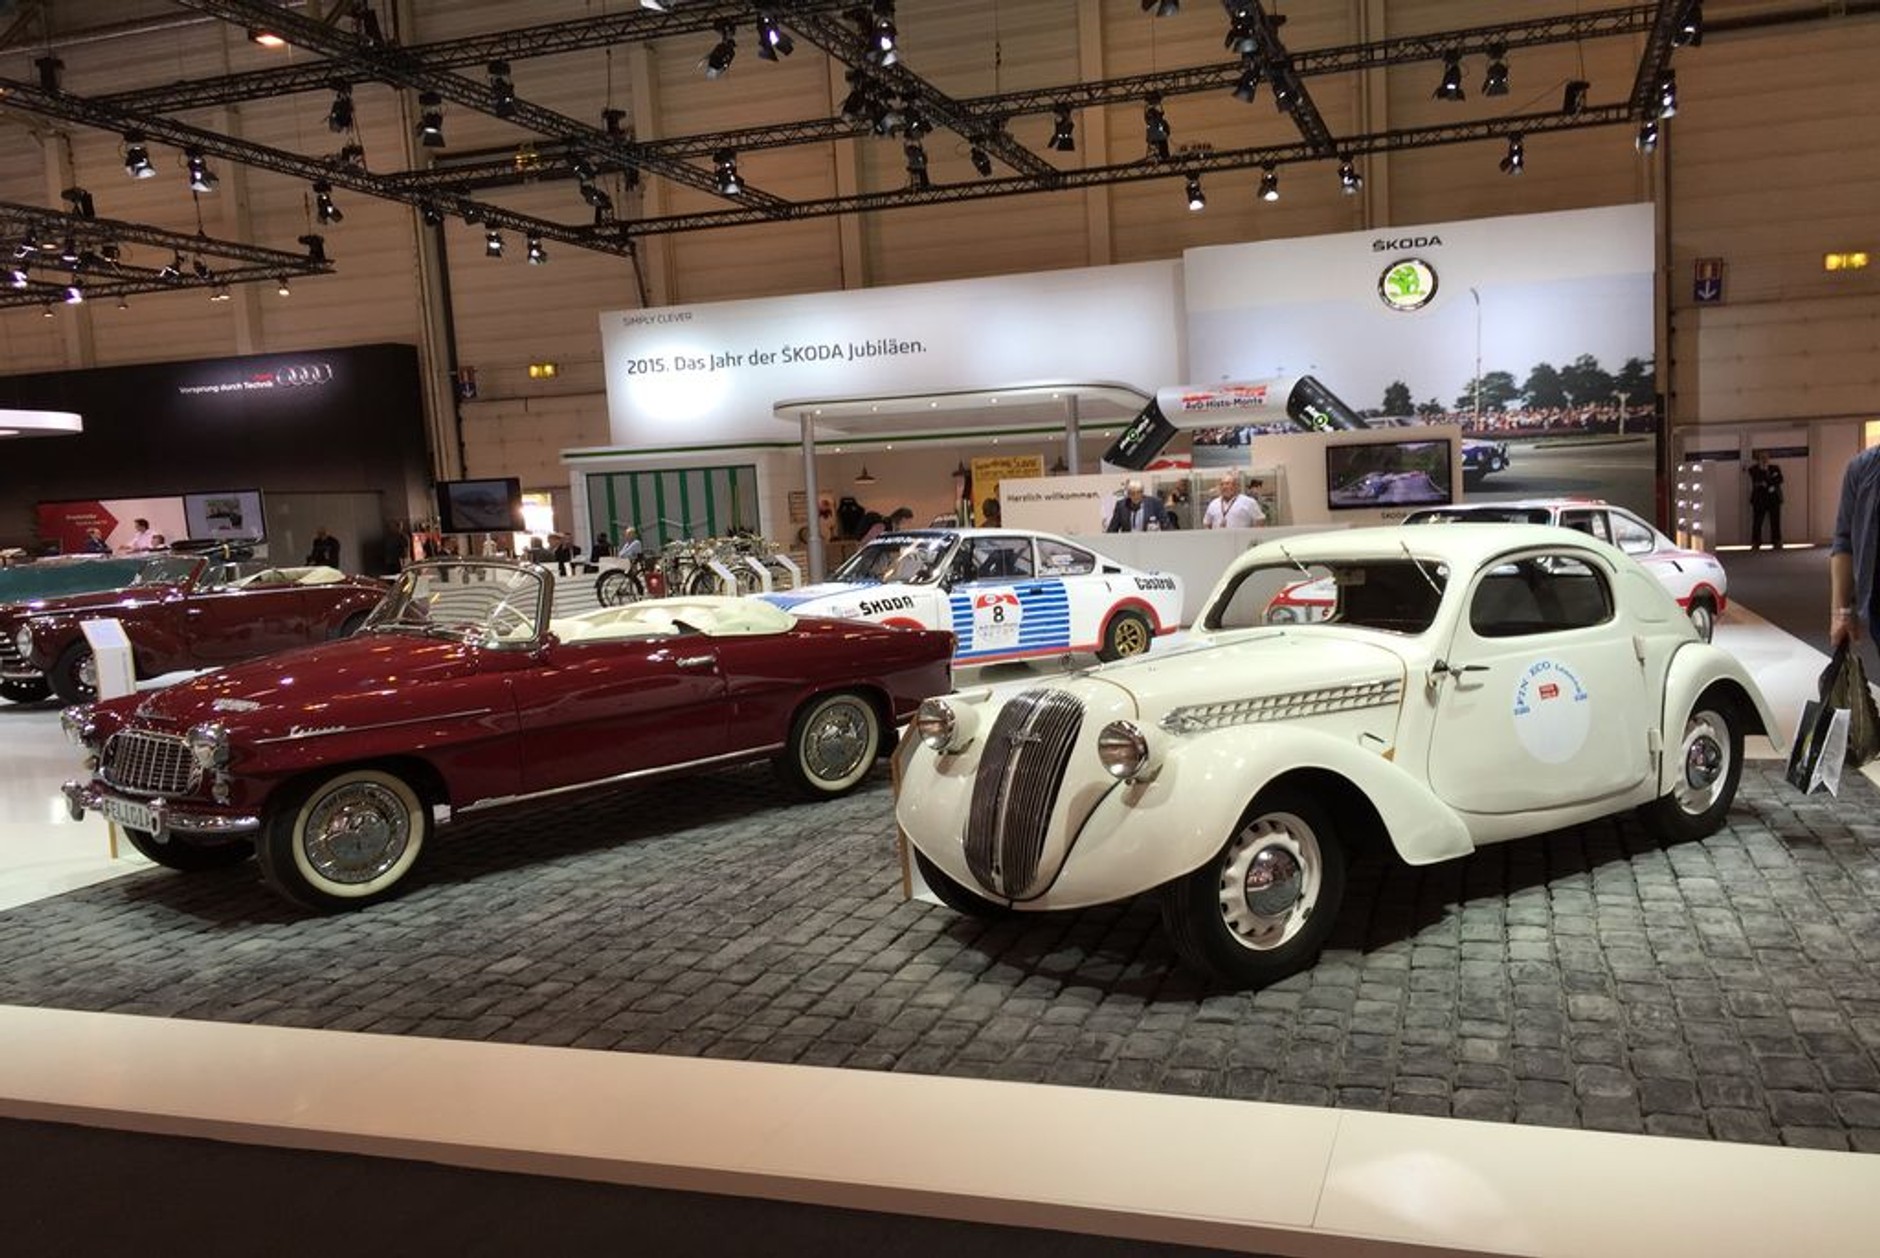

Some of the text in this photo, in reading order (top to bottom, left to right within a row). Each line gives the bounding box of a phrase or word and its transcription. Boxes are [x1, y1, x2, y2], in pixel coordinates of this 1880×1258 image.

[623, 311, 692, 326] SIMPLY CLEVER
[627, 338, 927, 375] 2015. Das Jahr der ŠKODA Jubiläen.
[220, 382, 242, 391] durch
[243, 380, 274, 389] Technik
[1133, 577, 1177, 591] Castrol
[993, 605, 1005, 624] 8
